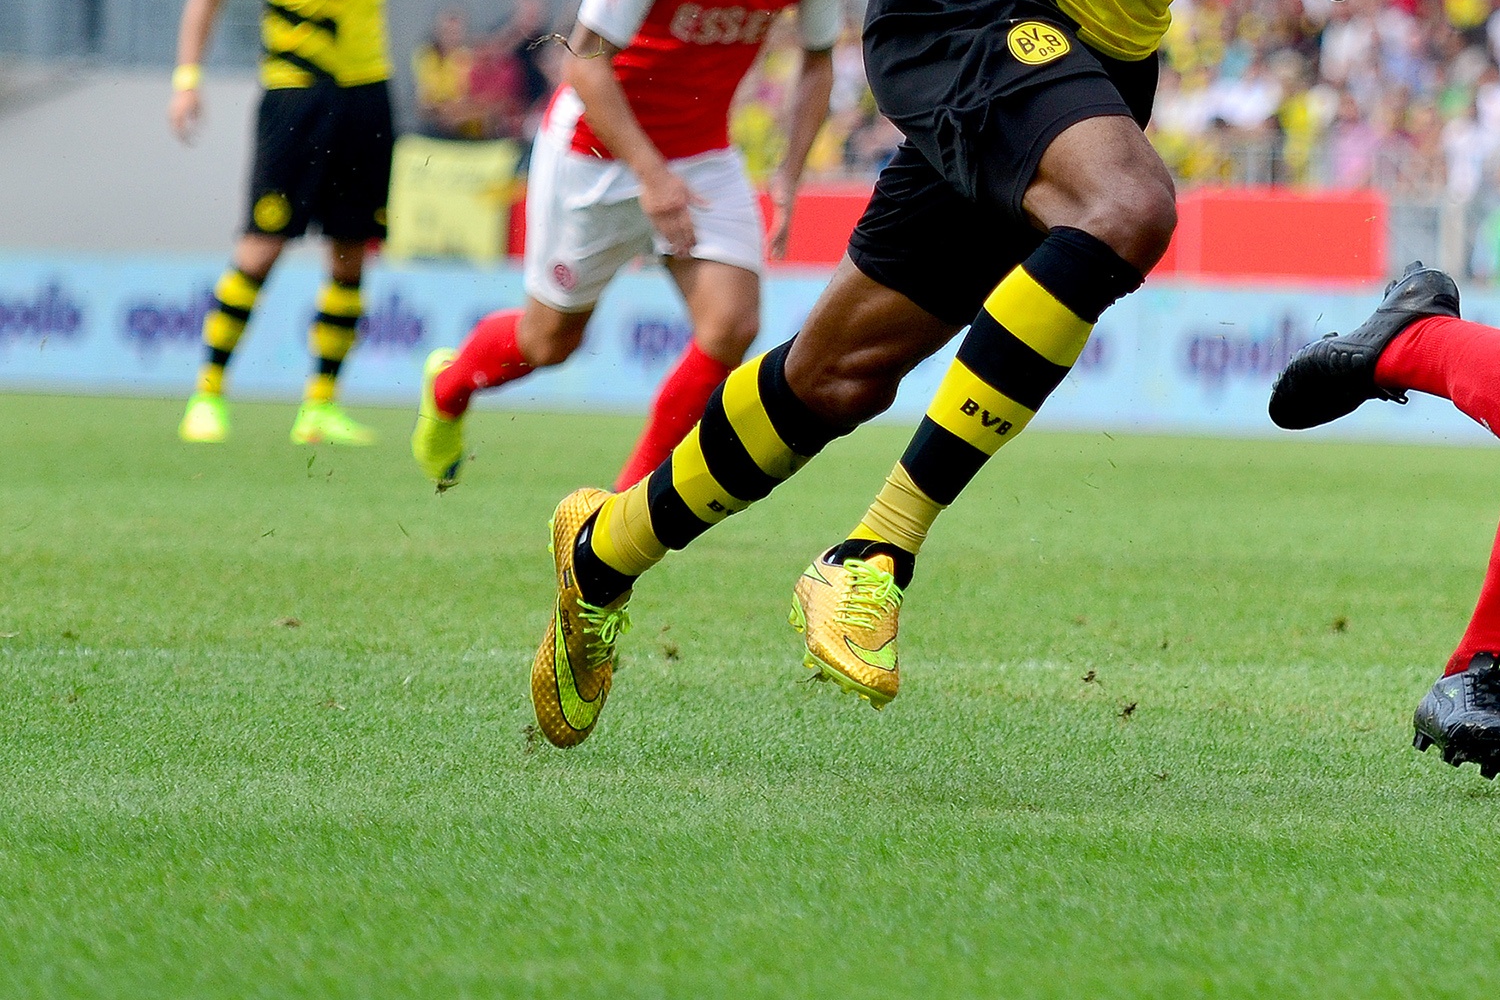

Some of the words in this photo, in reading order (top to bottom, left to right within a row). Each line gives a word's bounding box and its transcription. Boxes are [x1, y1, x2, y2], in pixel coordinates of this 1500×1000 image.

[1015, 28, 1061, 55] BVB
[1038, 46, 1056, 57] 09
[960, 397, 1013, 436] BVB
